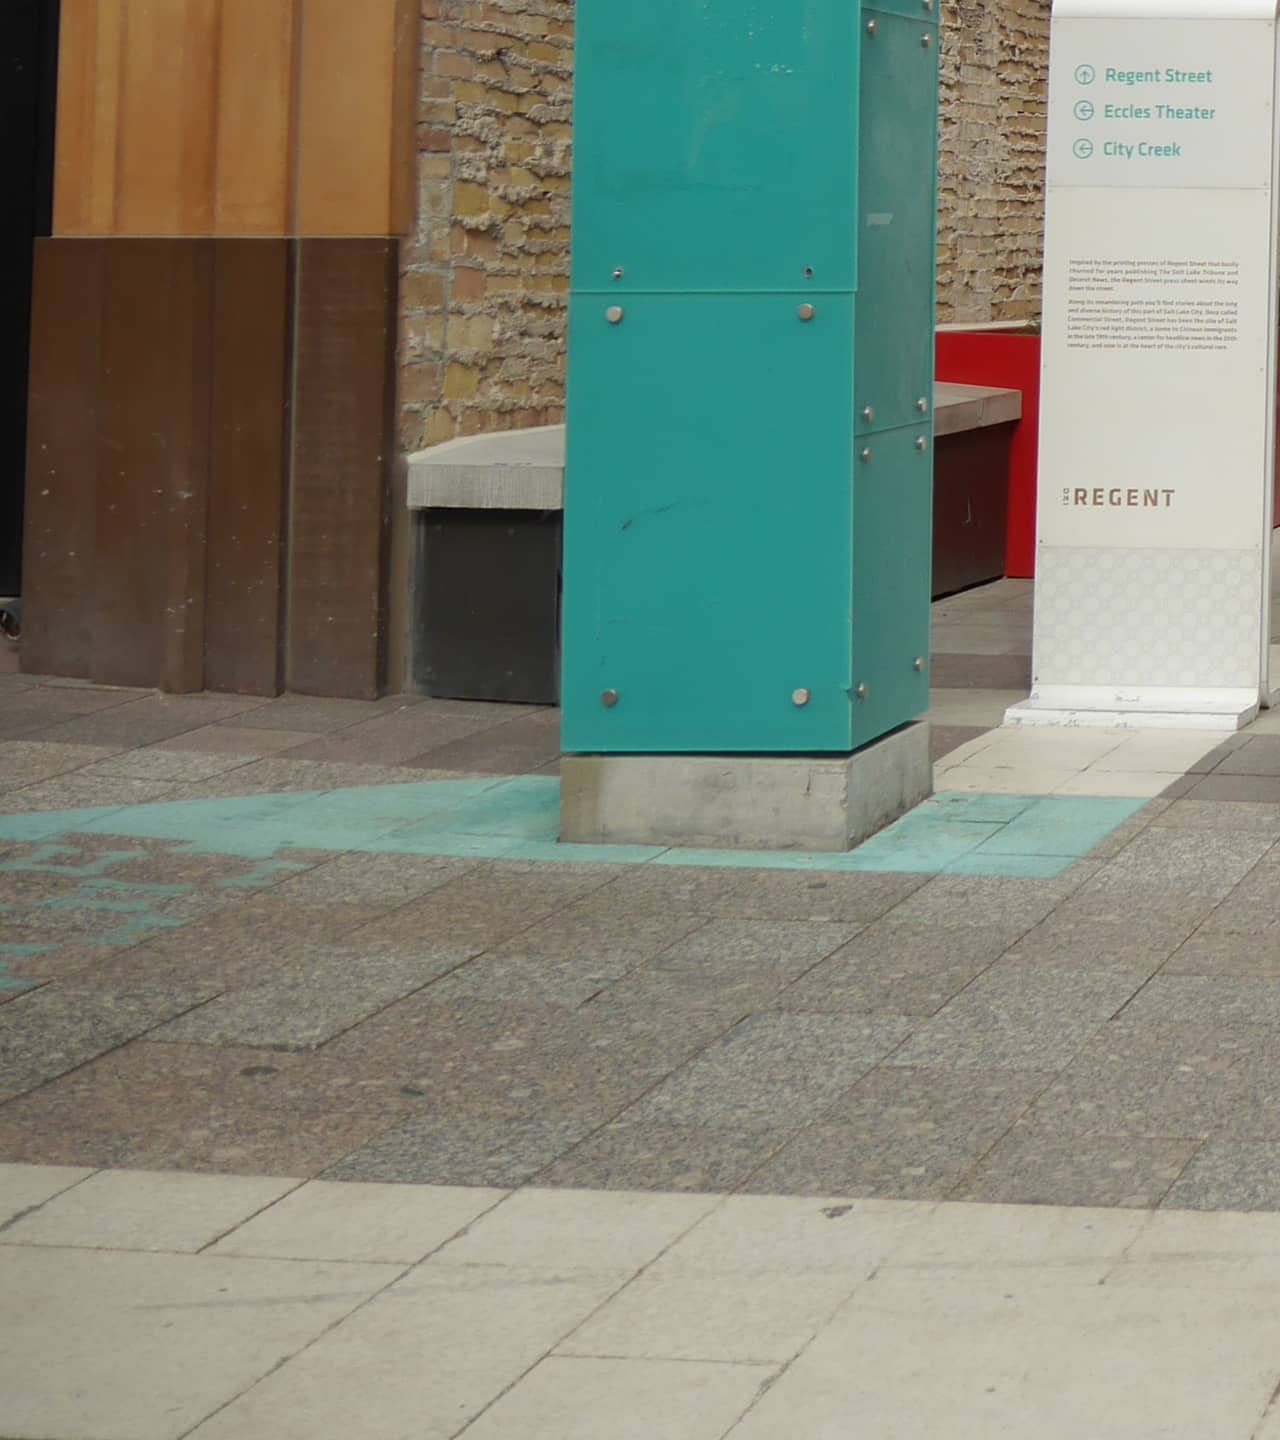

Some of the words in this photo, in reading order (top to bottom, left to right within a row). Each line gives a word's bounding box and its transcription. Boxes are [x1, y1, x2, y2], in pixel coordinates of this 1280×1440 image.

[1105, 68, 1161, 85] Regent
[1165, 68, 1212, 83] Street
[1104, 104, 1151, 119] Eccles
[1155, 105, 1216, 119] Theater
[1103, 141, 1134, 160] City
[1138, 141, 1181, 157] Creek
[1074, 488, 1175, 507] REGENT
